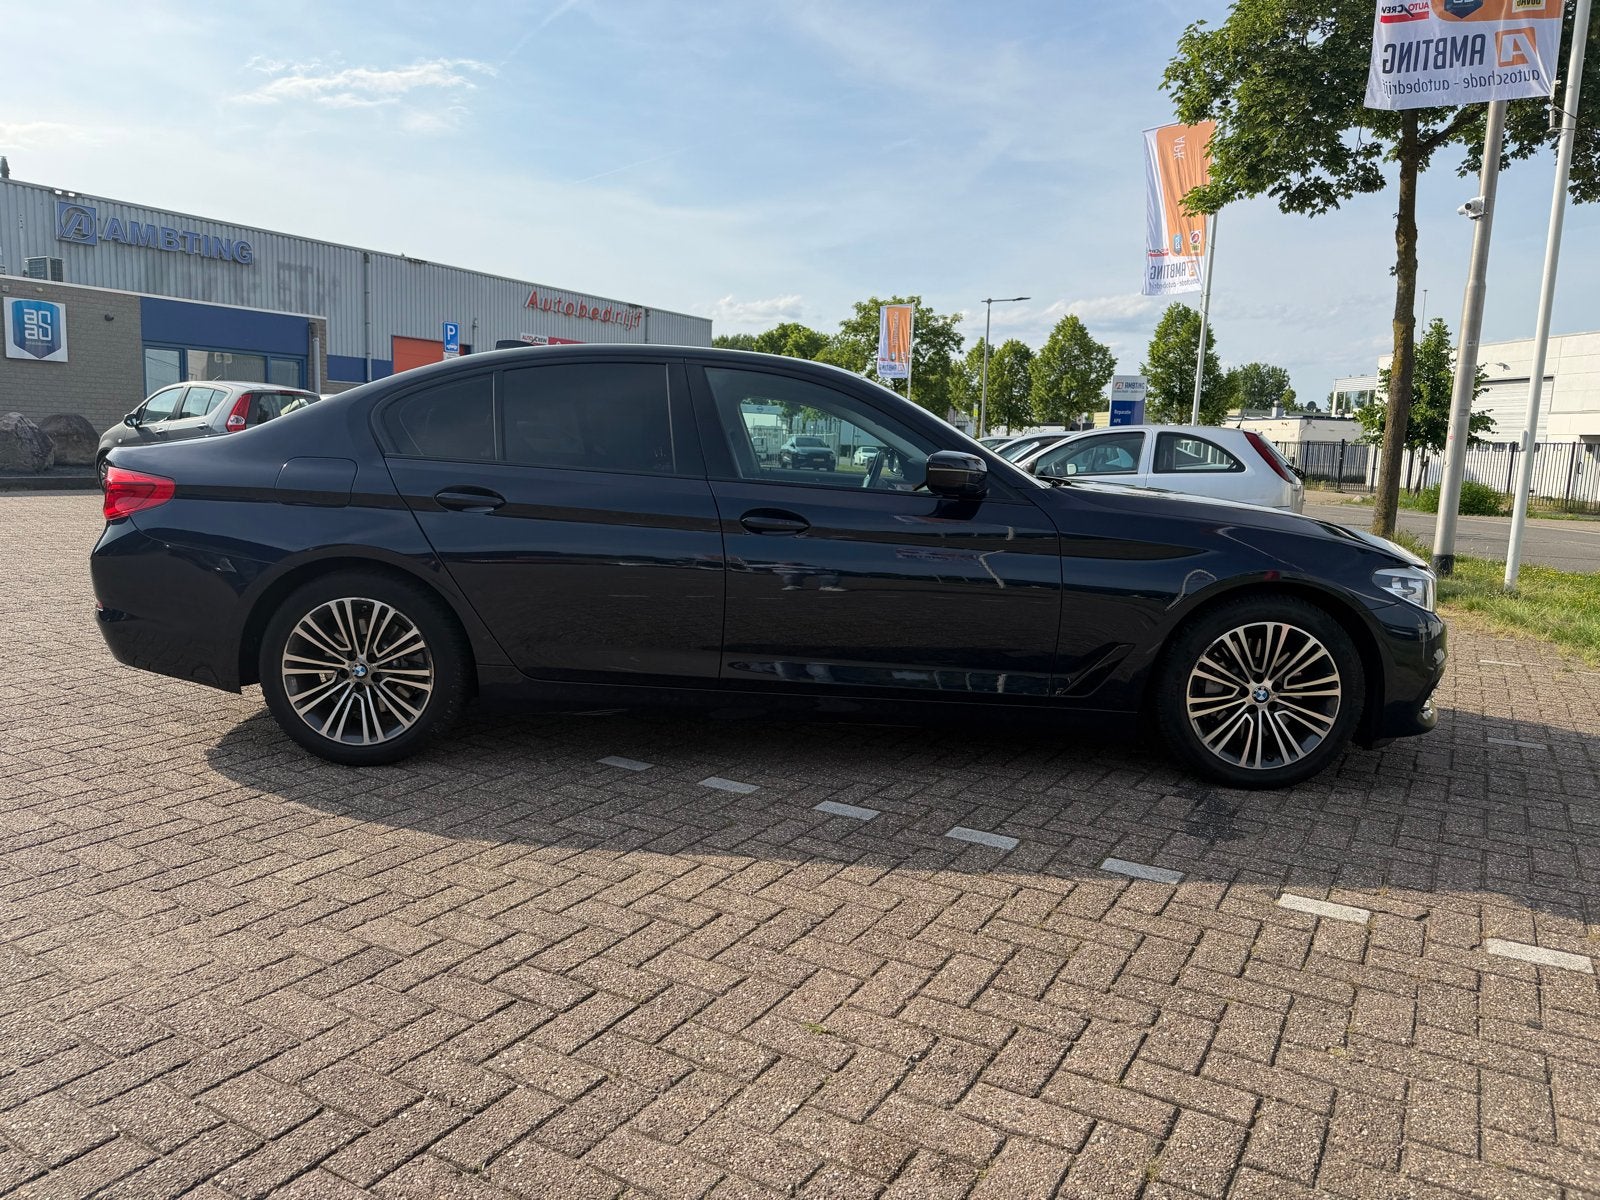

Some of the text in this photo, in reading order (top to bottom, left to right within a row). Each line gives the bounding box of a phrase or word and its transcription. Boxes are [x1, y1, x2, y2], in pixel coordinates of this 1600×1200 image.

[102, 217, 254, 264] AMBTING
[525, 290, 642, 330] Autobedrijf
[447, 325, 456, 340] P
